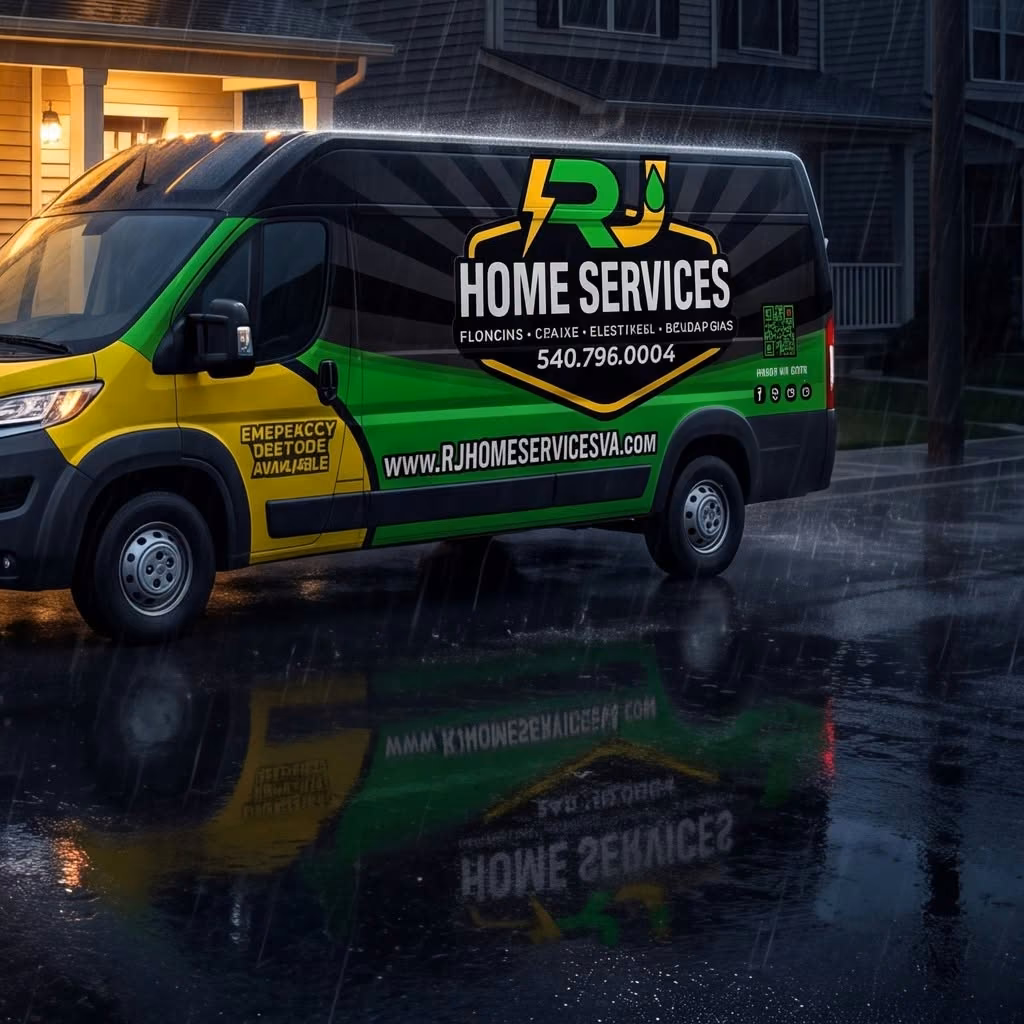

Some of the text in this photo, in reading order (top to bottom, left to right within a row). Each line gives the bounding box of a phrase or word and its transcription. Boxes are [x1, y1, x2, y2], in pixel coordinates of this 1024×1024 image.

[459, 259, 731, 318] HOME SERVICES
[460, 328, 524, 343] FLONCINS
[537, 343, 676, 369] 540.796.0004
